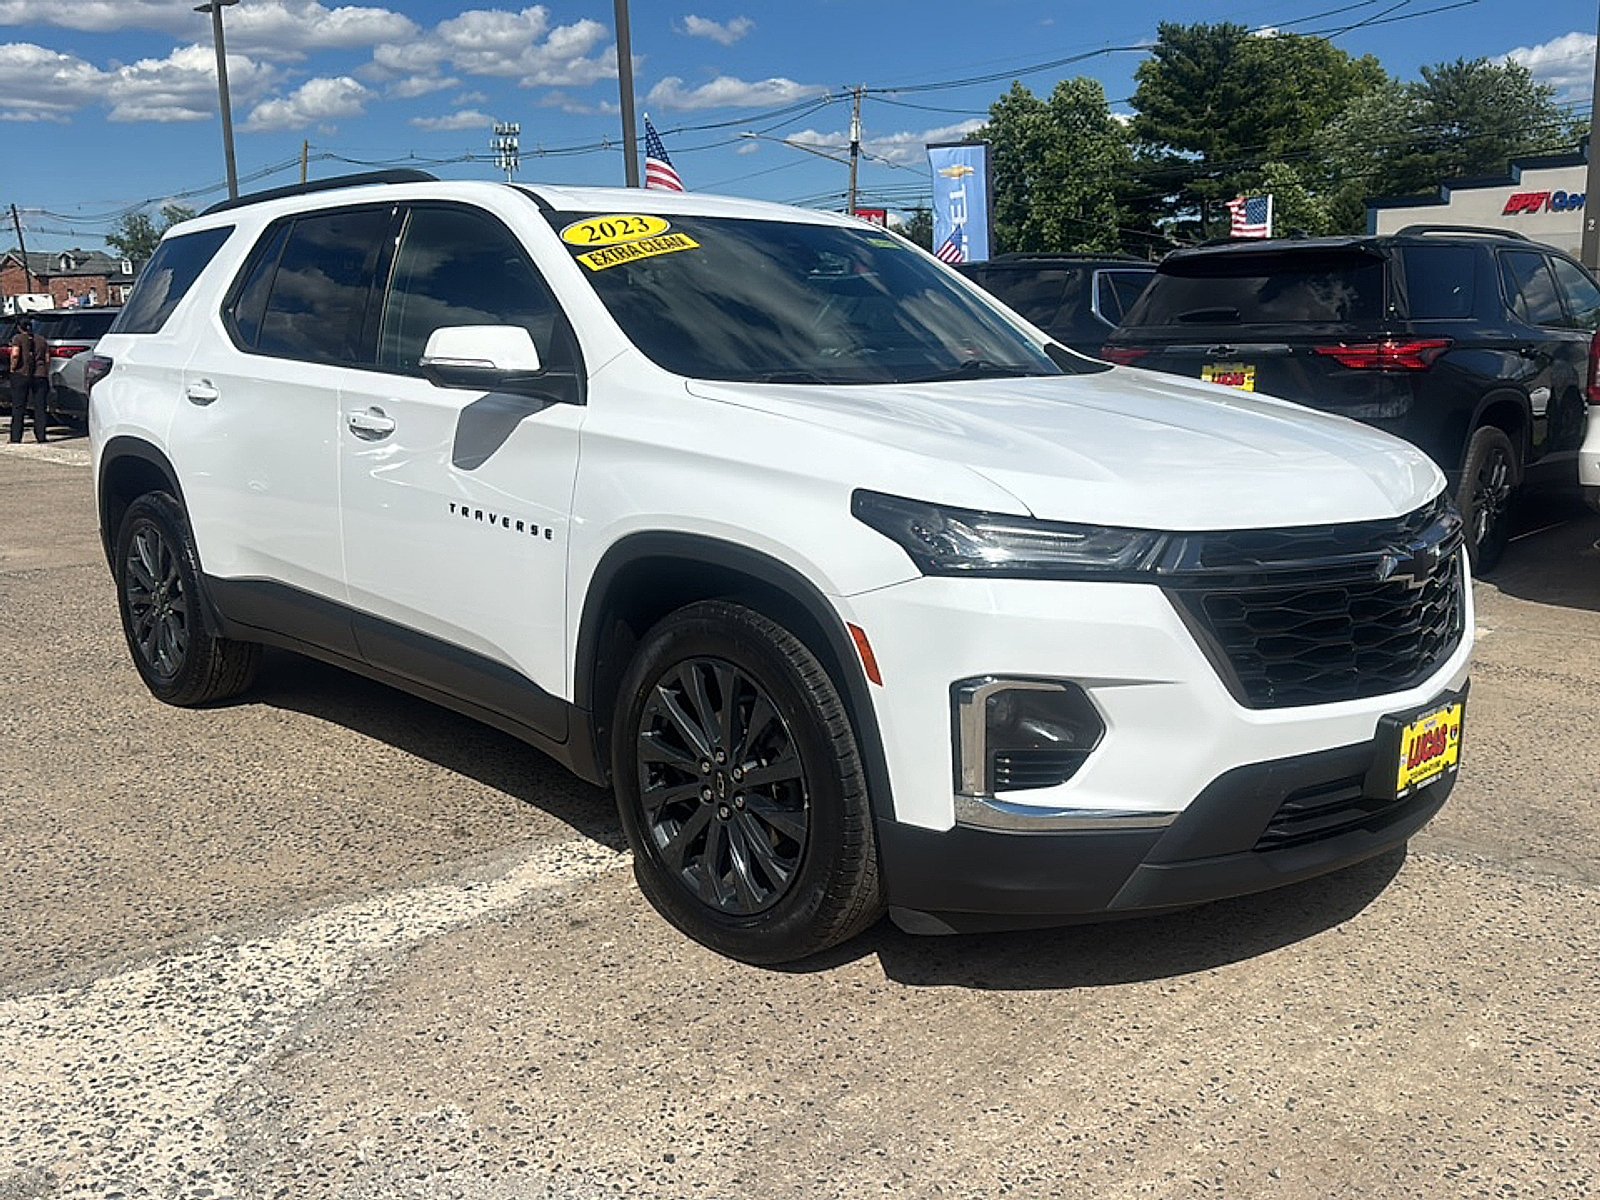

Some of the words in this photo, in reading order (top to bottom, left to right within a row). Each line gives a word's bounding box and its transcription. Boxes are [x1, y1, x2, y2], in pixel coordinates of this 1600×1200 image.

[581, 216, 650, 243] 2023
[1588, 219, 1595, 231] 2
[587, 243, 642, 267] EXTRA
[638, 234, 690, 254] CLEAN
[450, 503, 553, 540] TRAVERSE
[1406, 723, 1448, 771] LUCAS
